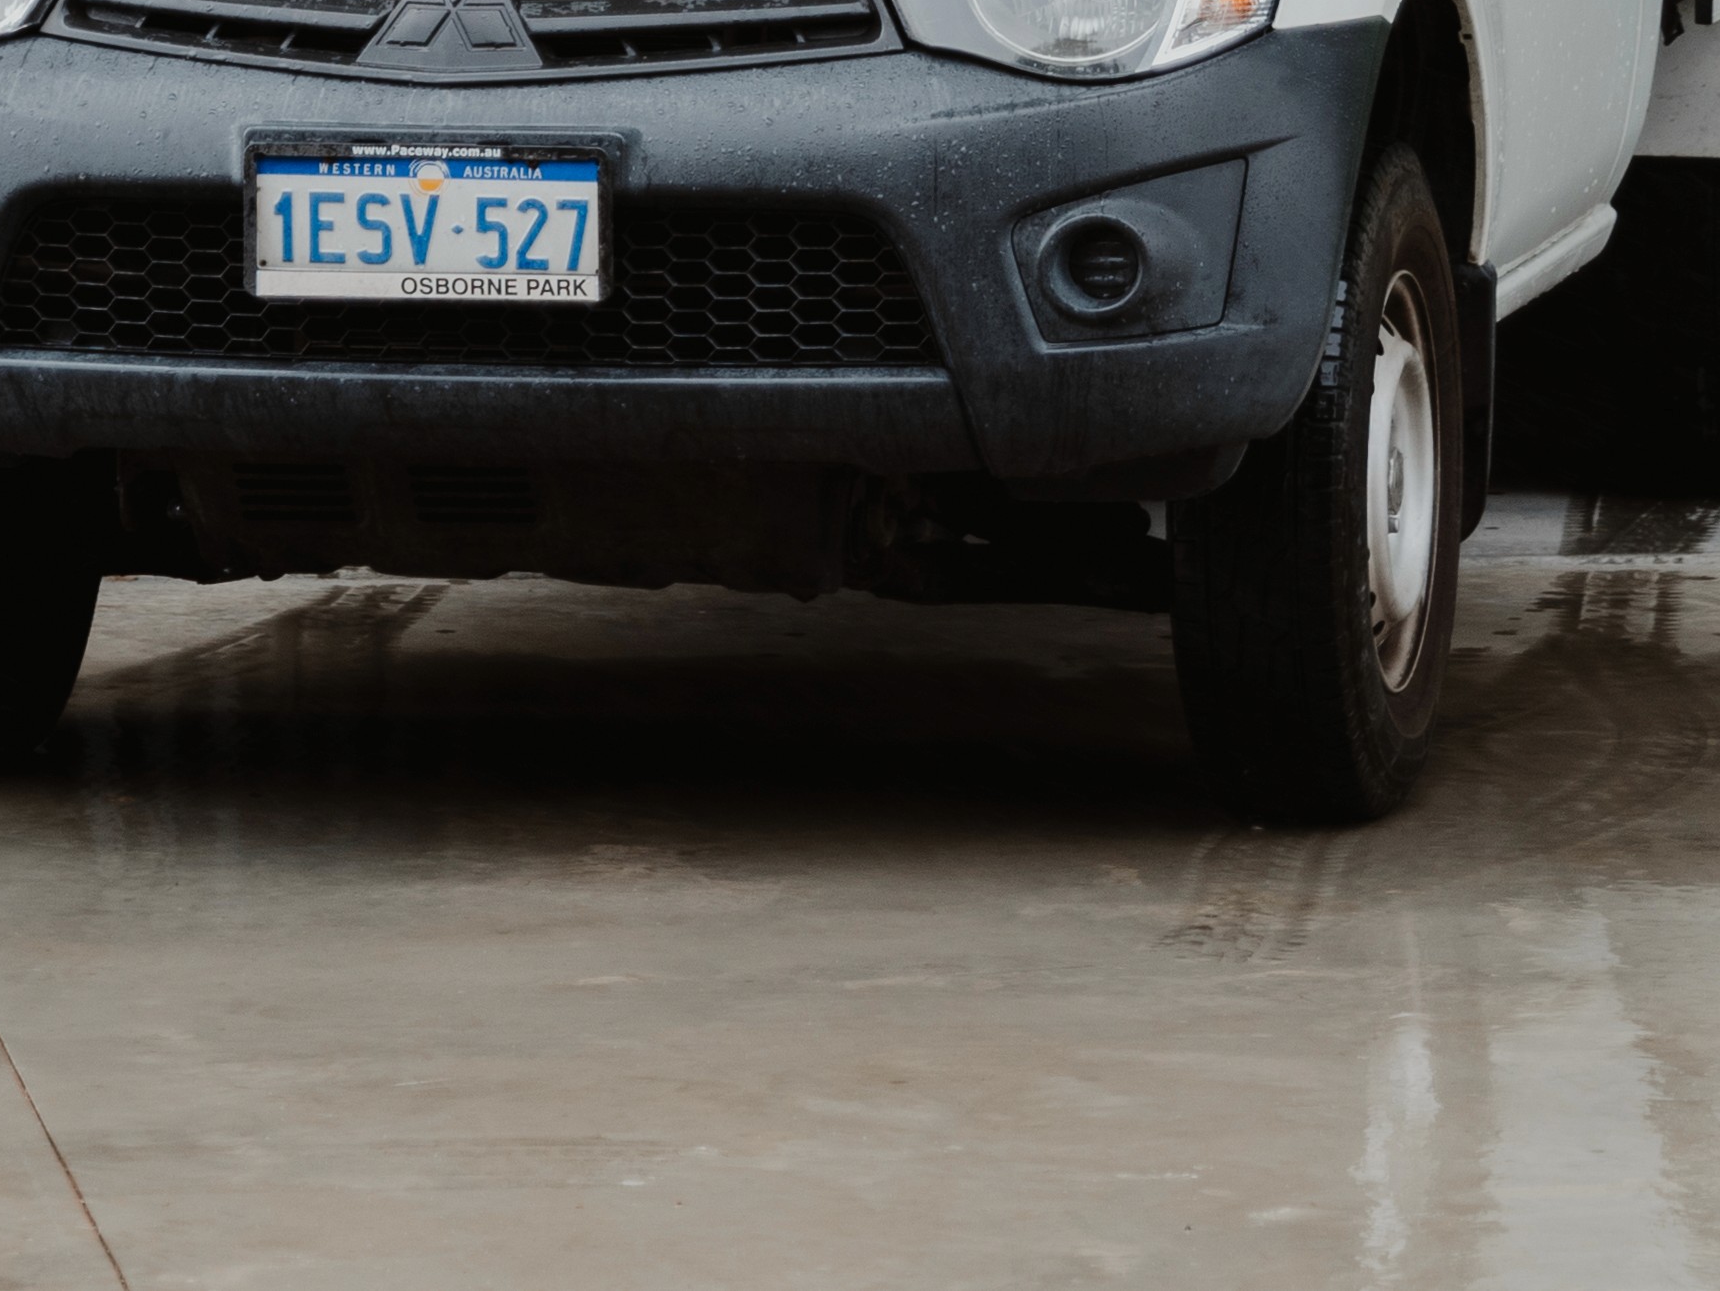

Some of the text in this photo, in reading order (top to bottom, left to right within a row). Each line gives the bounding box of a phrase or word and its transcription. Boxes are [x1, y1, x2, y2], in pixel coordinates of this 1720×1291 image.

[351, 144, 502, 159] www.Paceway.com.au
[318, 162, 543, 179] WESTERN AUSTRALIA
[400, 277, 588, 297] OSBORNE PARK
